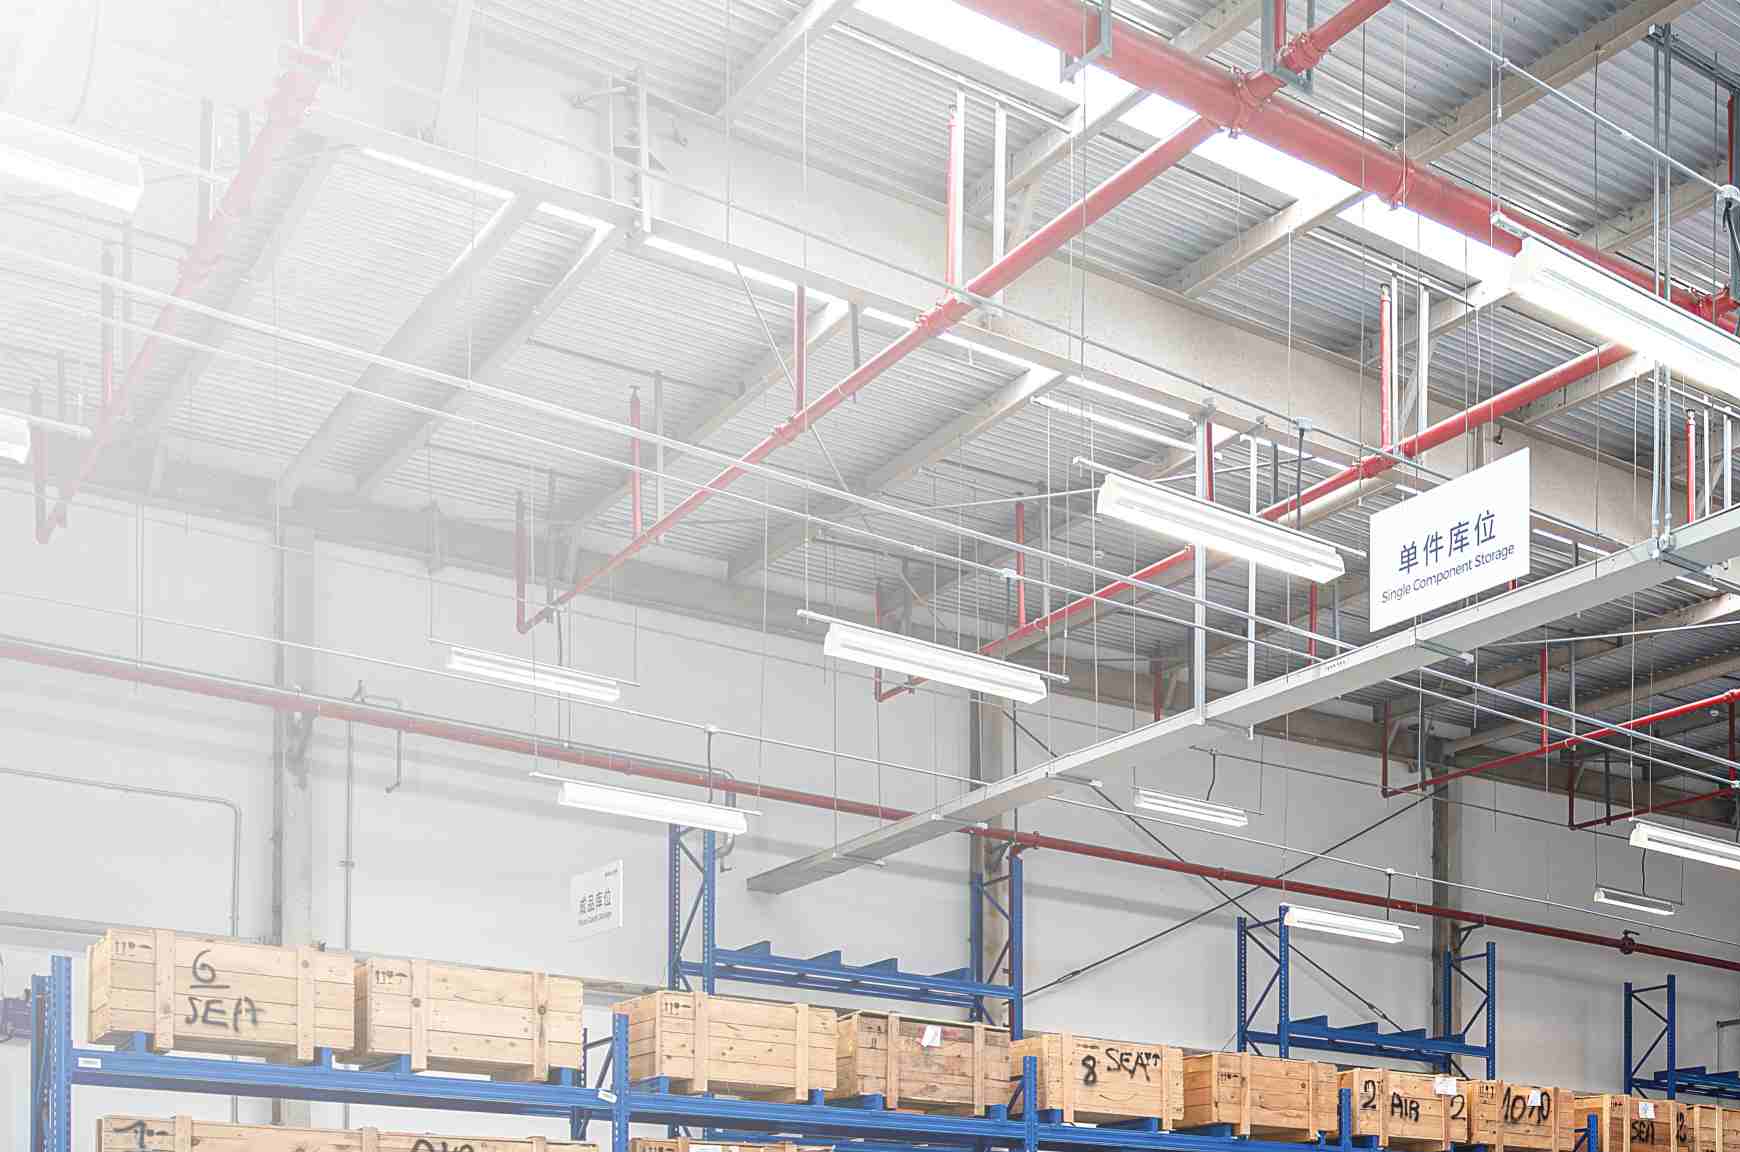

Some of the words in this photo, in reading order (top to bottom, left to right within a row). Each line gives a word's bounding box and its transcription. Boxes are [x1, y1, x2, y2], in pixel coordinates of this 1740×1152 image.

[1398, 509, 1497, 575] 单件库位
[1382, 583, 1412, 603] Single
[1412, 559, 1473, 593] Component
[1473, 543, 1516, 568] Storage
[184, 995, 266, 1032] SEA
[1081, 1054, 1097, 1087] 8
[1104, 1047, 1152, 1082] SEA
[1361, 1079, 1377, 1109] 2
[1391, 1090, 1420, 1123] AIR
[1449, 1094, 1466, 1121] 2
